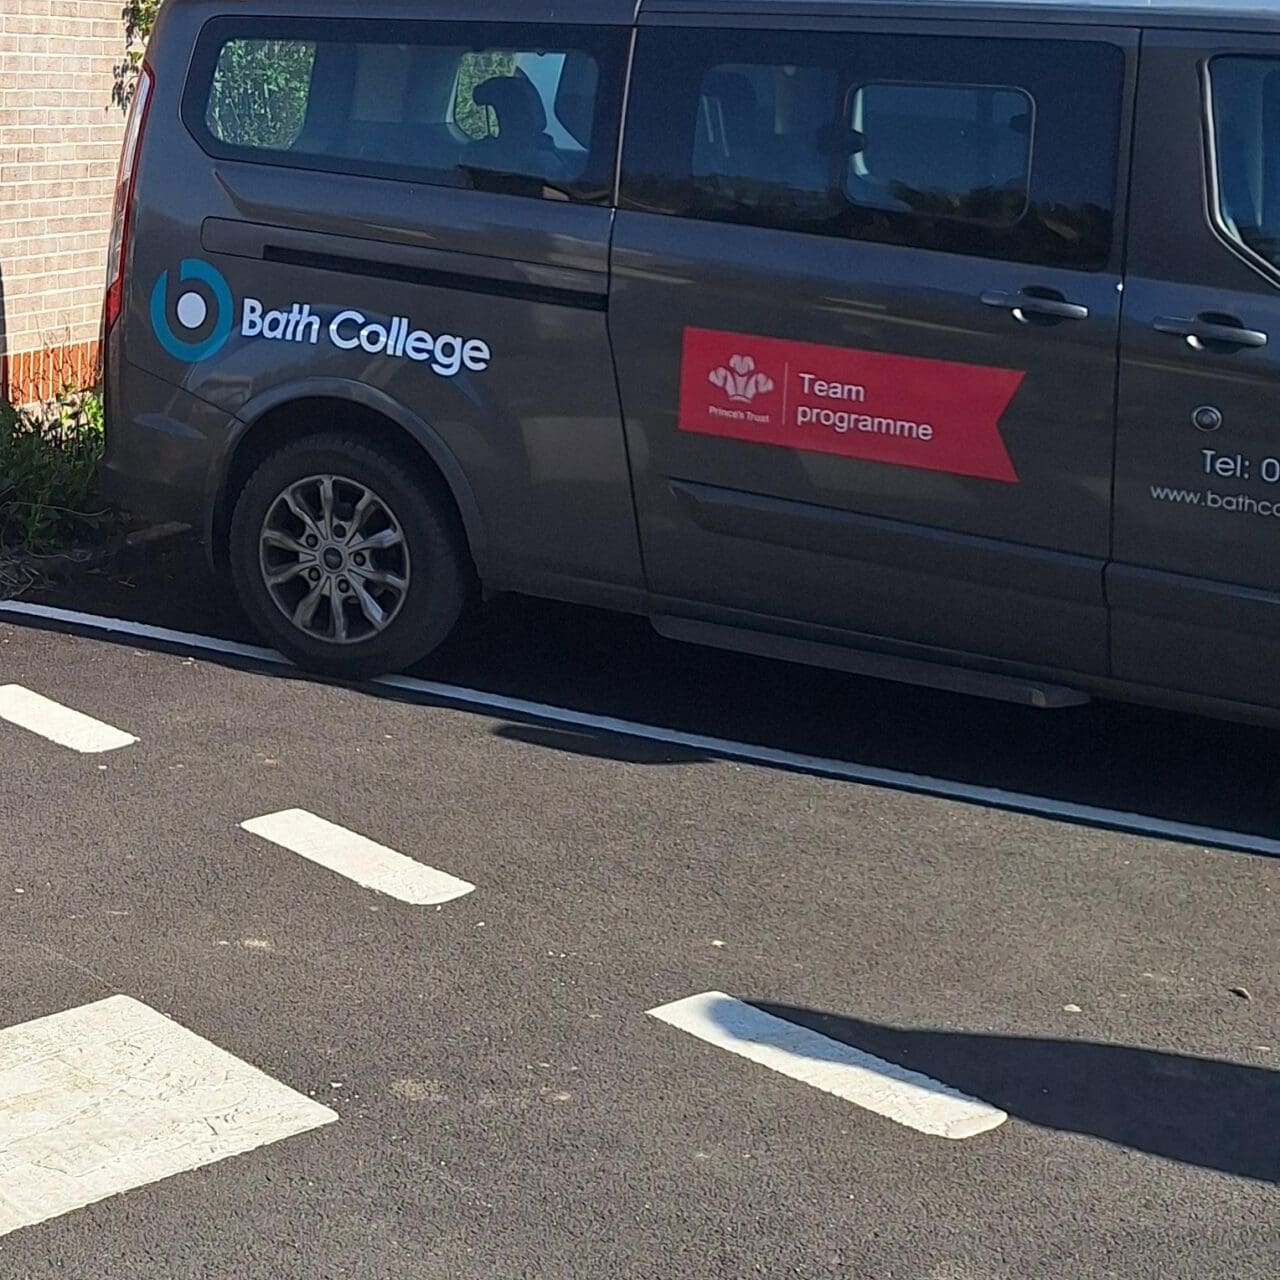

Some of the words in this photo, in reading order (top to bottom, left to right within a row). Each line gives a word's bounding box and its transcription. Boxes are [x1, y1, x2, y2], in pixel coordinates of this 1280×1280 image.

[241, 297, 320, 344] Bath
[329, 310, 492, 377] College
[798, 372, 865, 402] Team
[745, 410, 769, 423] Trust
[797, 405, 934, 441] programme
[1201, 449, 1250, 480] Tel:
[1261, 458, 1280, 482] 0
